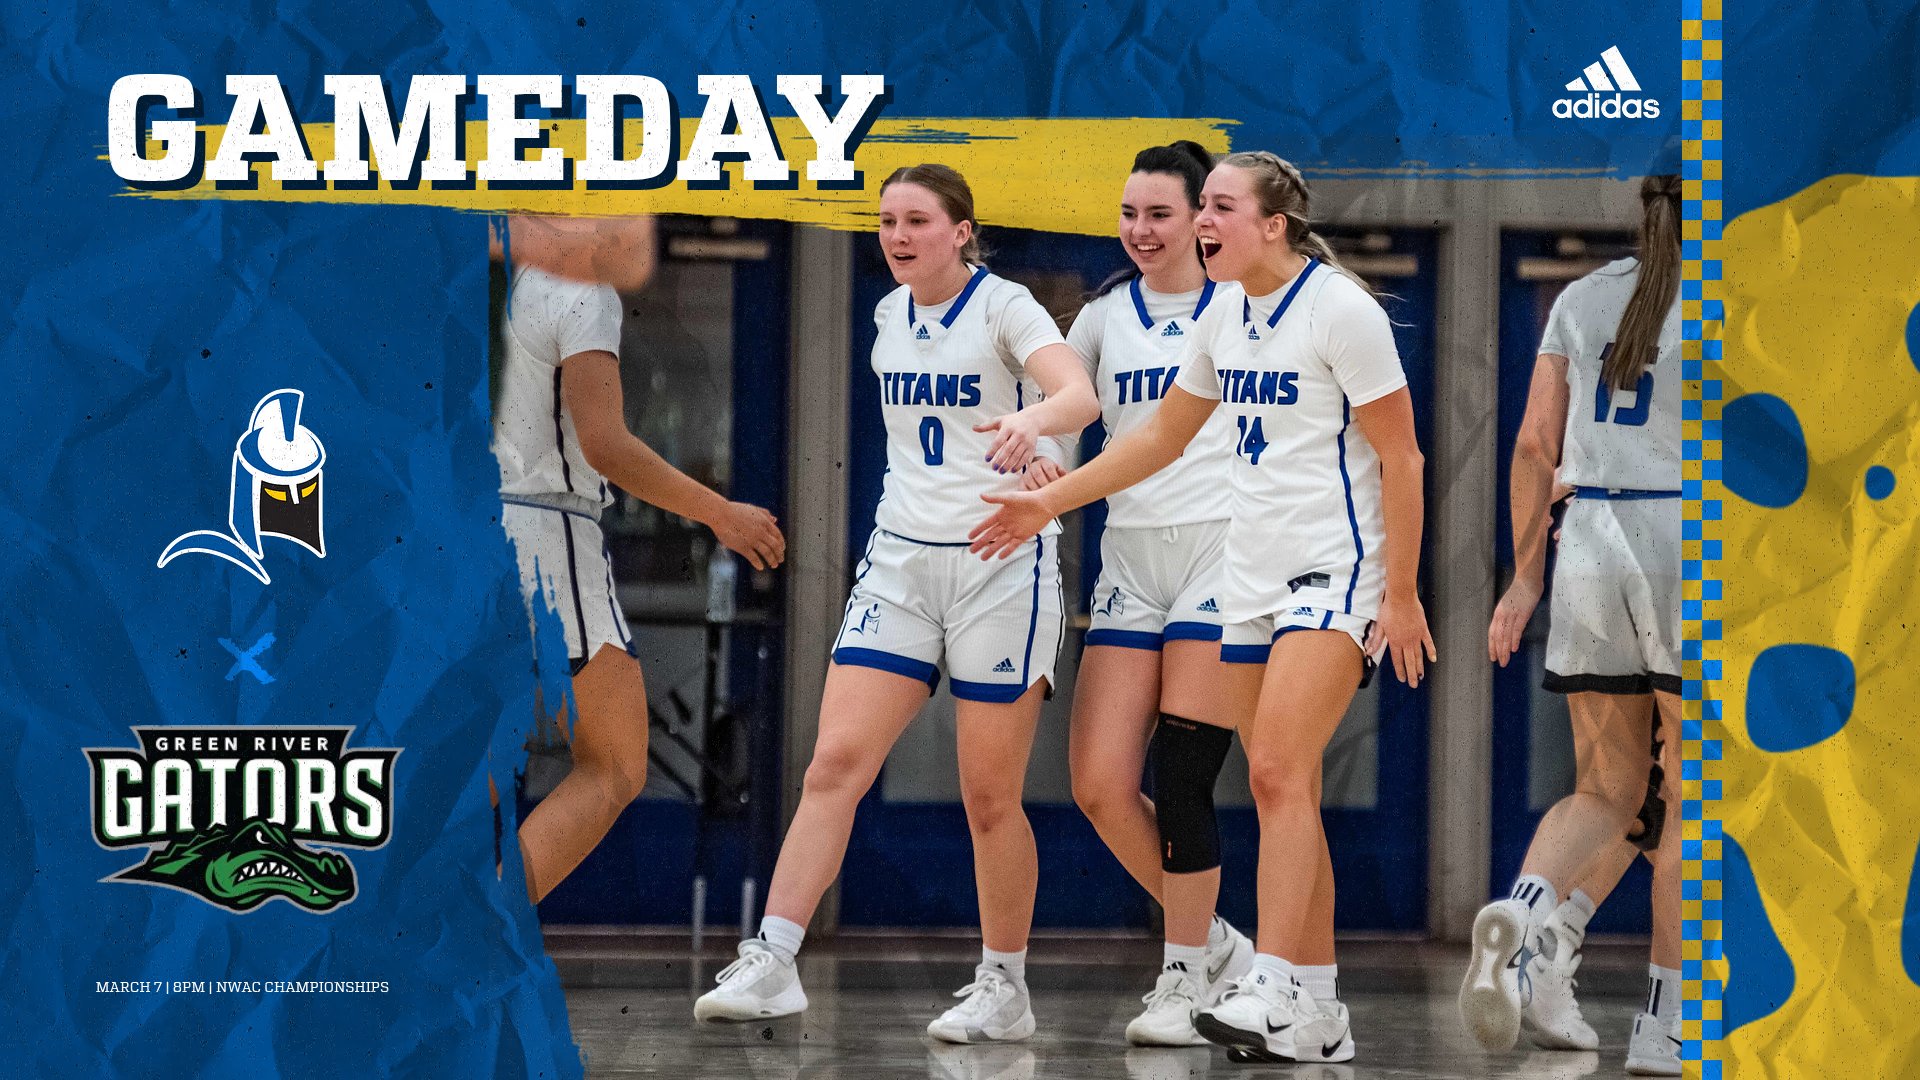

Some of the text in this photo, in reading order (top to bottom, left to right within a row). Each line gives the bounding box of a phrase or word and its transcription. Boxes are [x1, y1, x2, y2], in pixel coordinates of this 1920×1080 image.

[1161, 329, 1184, 337] adidas
[882, 372, 981, 407] TITANS
[919, 415, 944, 466] 0
[1236, 415, 1269, 466] 14
